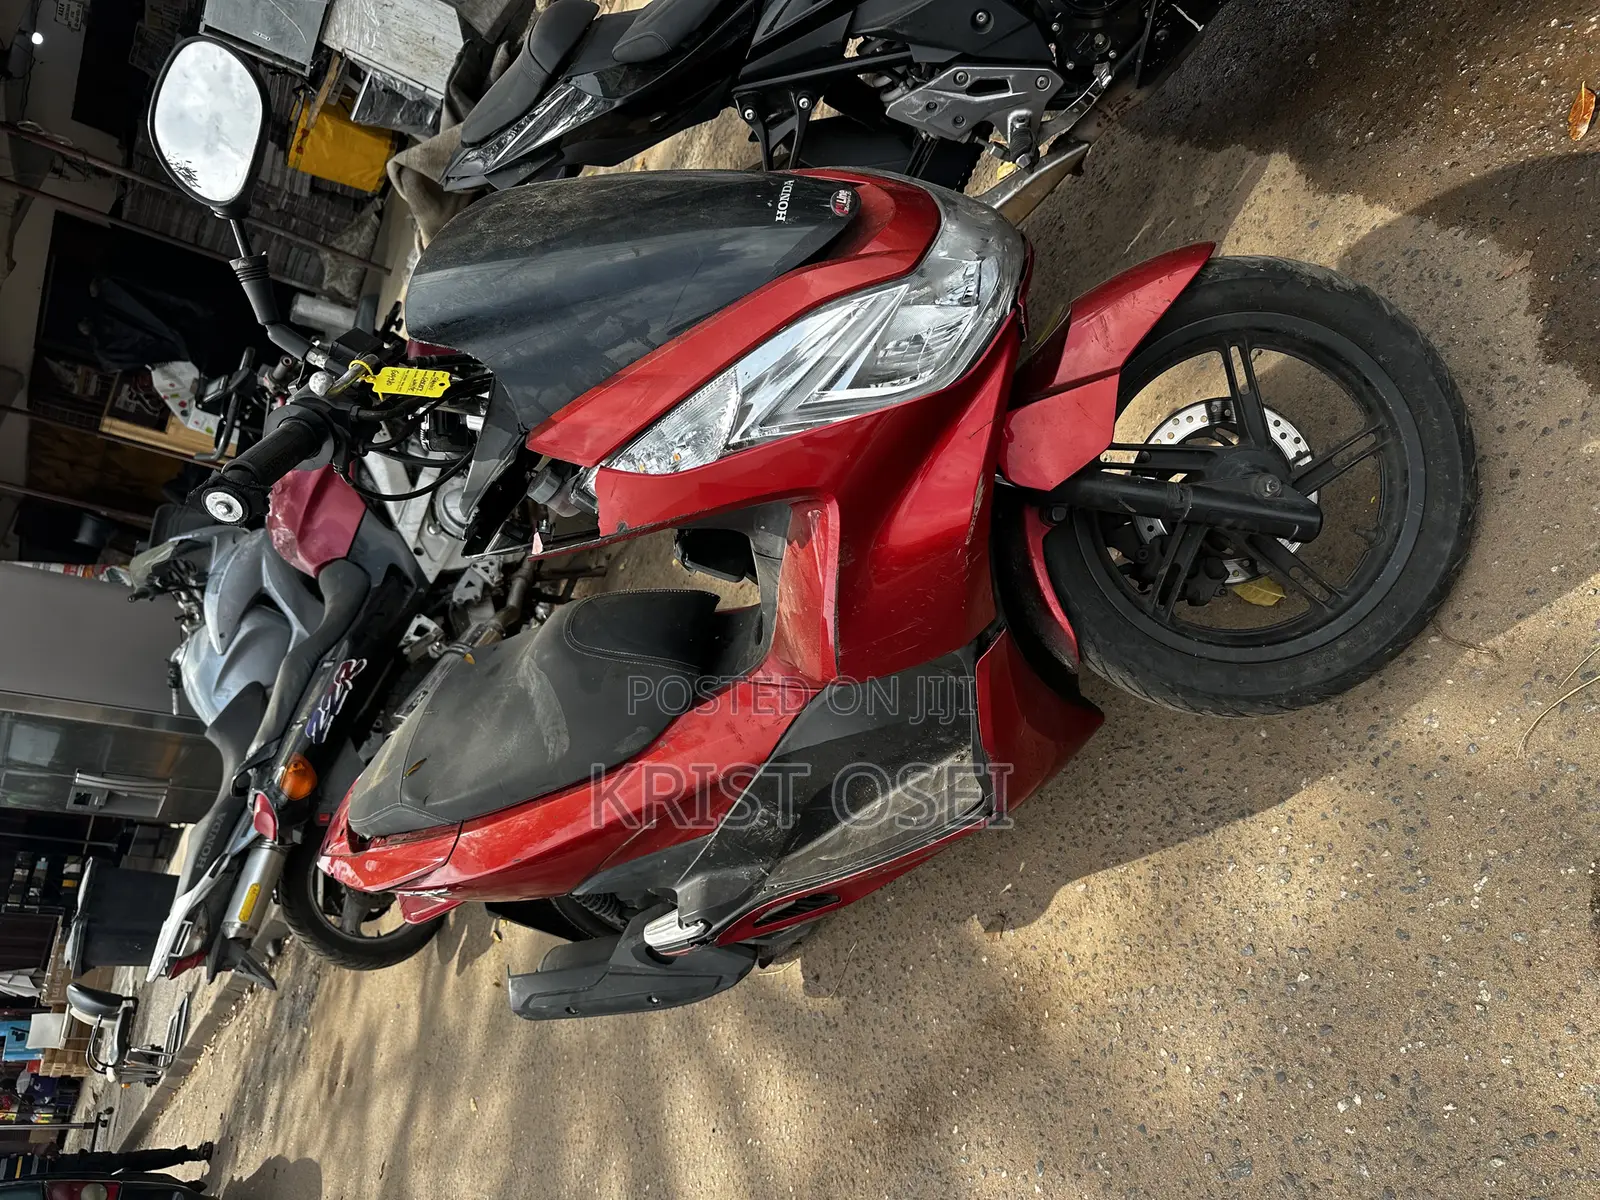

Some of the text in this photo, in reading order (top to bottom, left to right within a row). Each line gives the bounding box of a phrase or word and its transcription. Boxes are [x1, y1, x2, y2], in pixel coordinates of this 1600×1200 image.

[775, 180, 795, 222] HONDA
[305, 658, 368, 744] ZZR
[195, 812, 227, 869] HONDA
